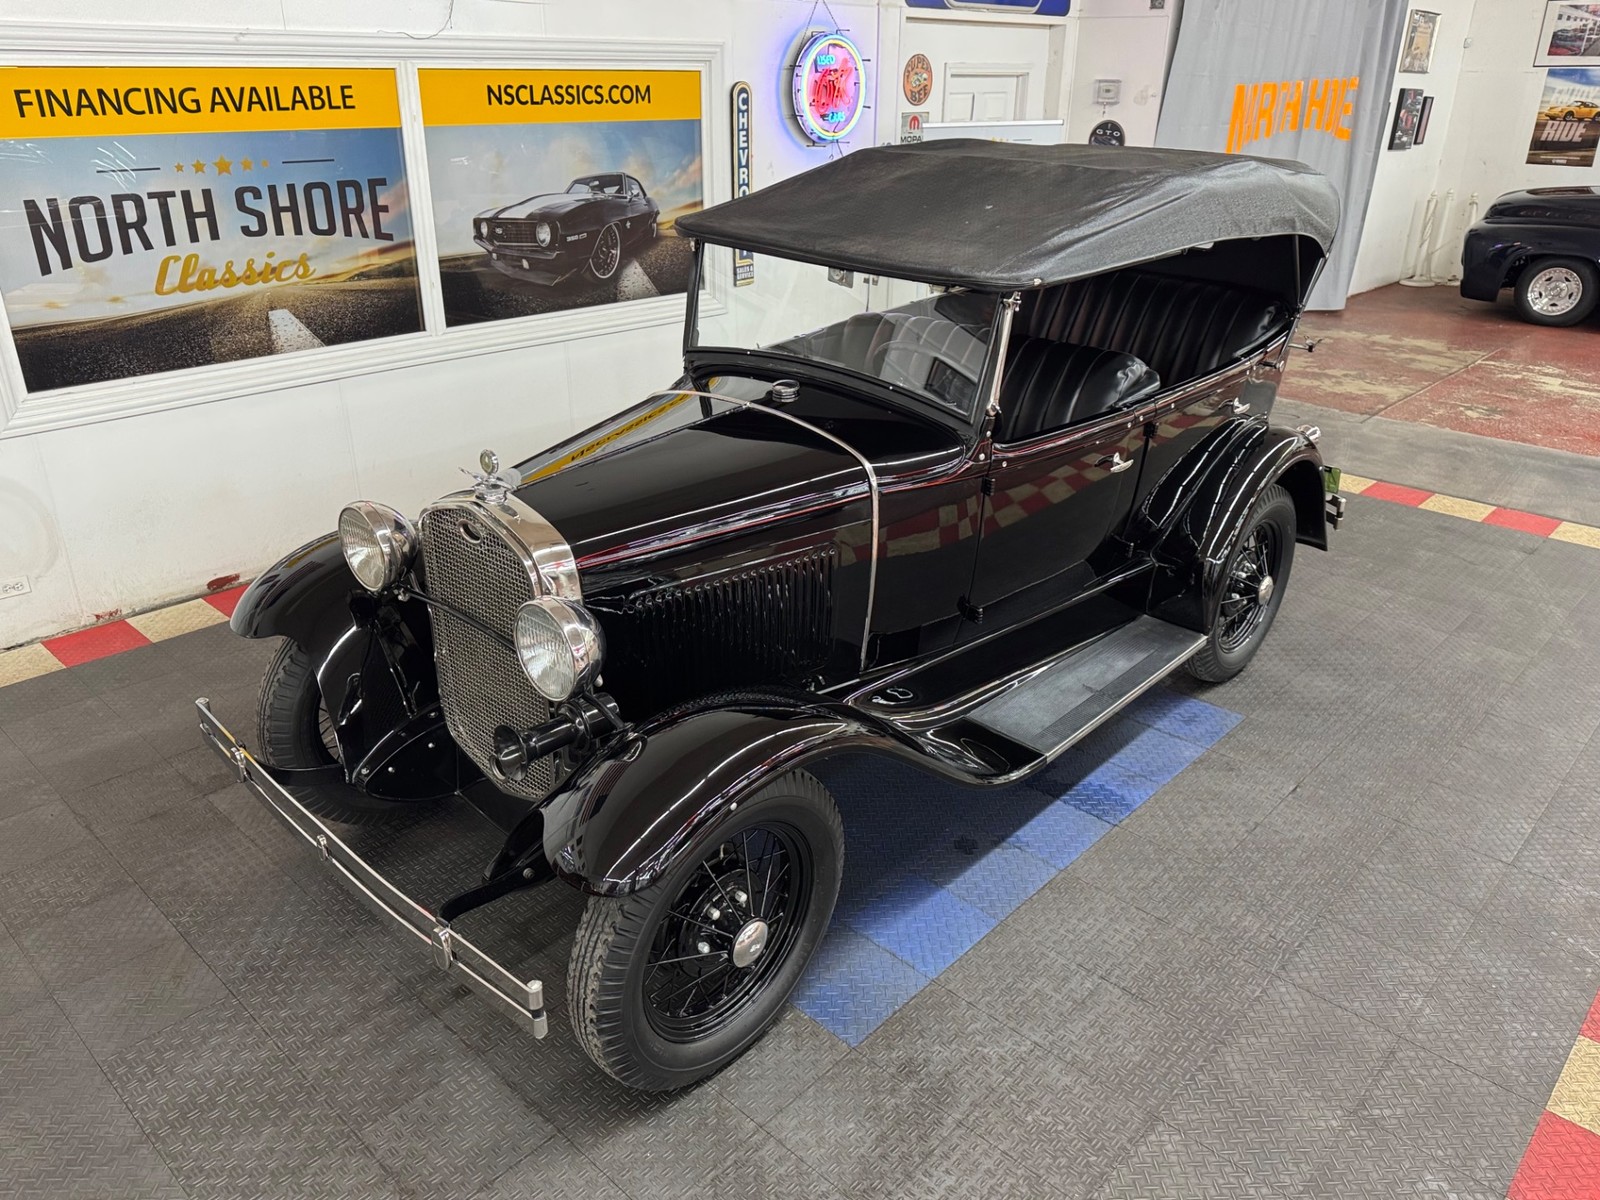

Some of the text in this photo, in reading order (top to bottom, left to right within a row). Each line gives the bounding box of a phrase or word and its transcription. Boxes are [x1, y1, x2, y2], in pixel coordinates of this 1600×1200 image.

[13, 84, 356, 118] FINANCING AVAILABLE
[486, 84, 651, 106] NSCLASSICS.COM
[910, 84, 929, 103] BEE
[901, 135, 924, 144] MOPA
[1096, 128, 1121, 137] GTO
[1540, 119, 1587, 142] RIDE
[23, 177, 395, 277] NORTH SHORE
[153, 250, 316, 296] Classics
